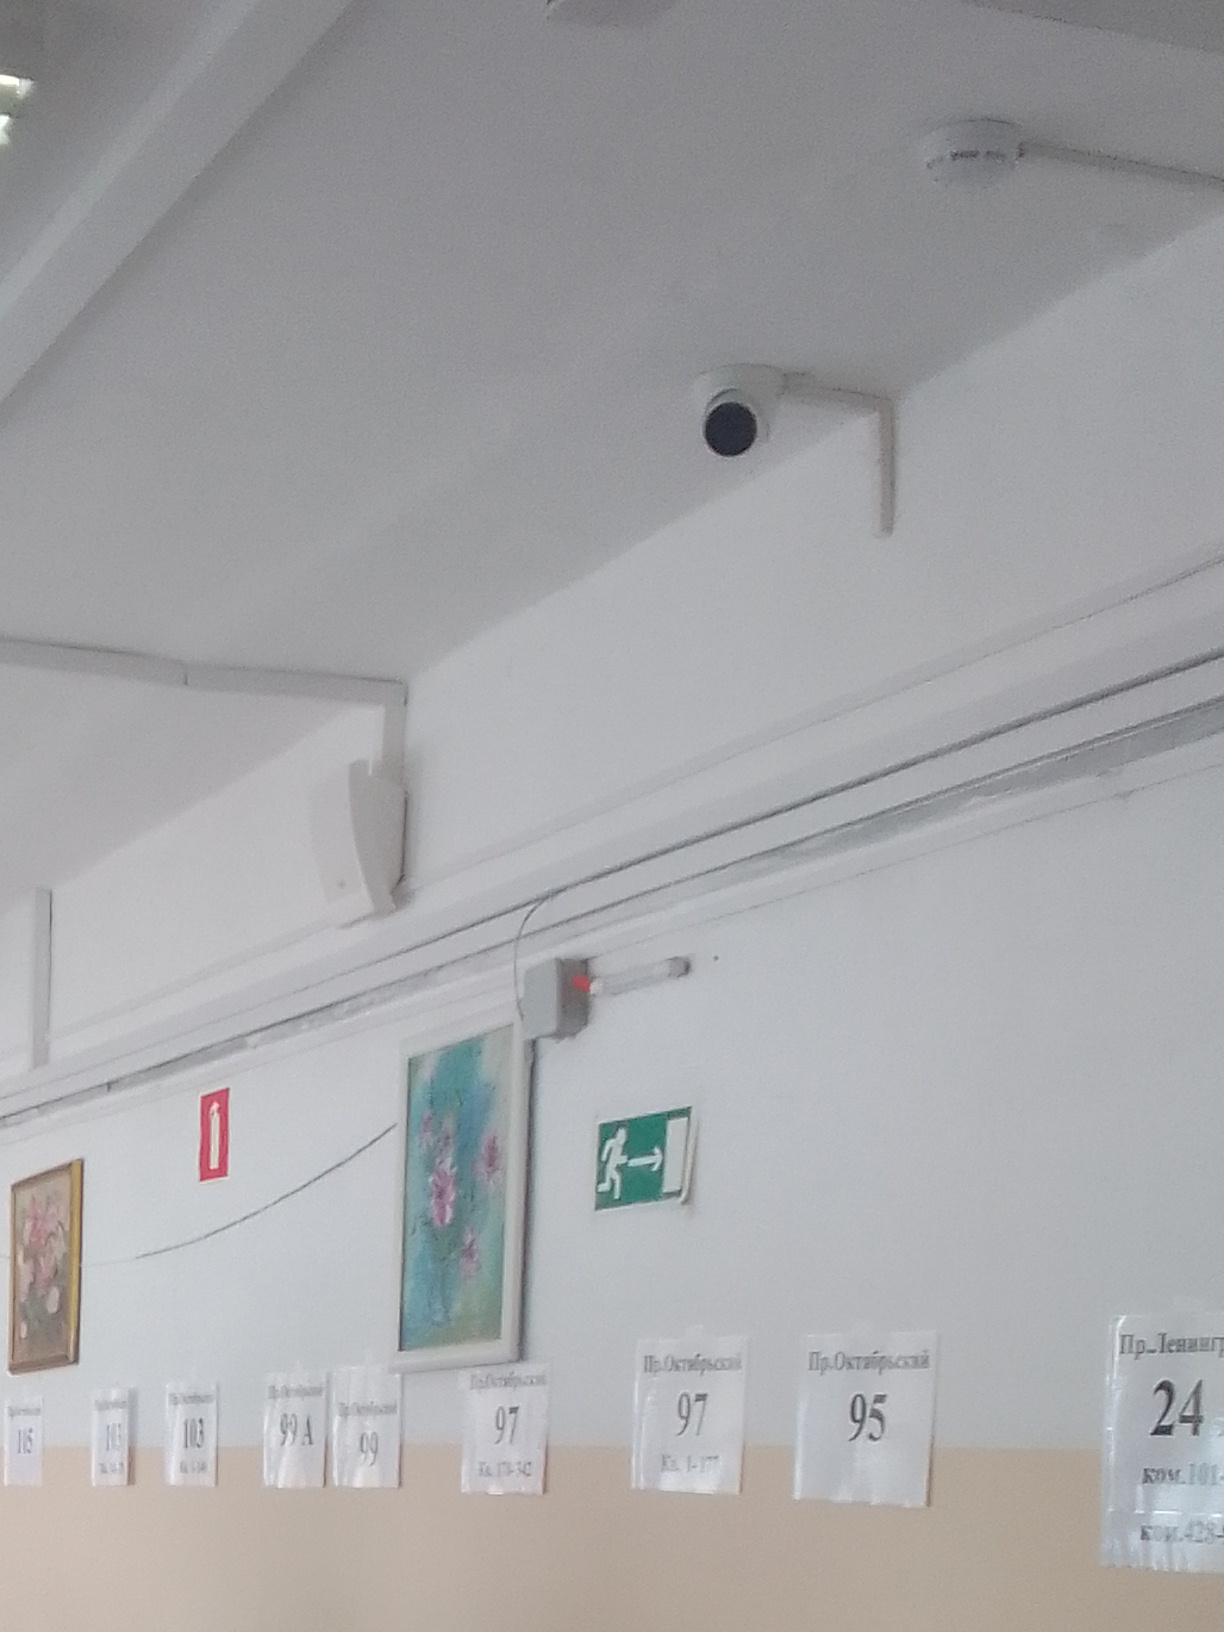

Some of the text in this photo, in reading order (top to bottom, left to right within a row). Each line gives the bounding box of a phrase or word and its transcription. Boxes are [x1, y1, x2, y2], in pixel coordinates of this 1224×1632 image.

[494, 1406, 520, 1445] 97
[676, 1391, 708, 1437] 97
[848, 1393, 887, 1441] 95
[1150, 1379, 1203, 1436] 24
[279, 1412, 298, 1447] 99
[359, 1431, 379, 1467] 99
